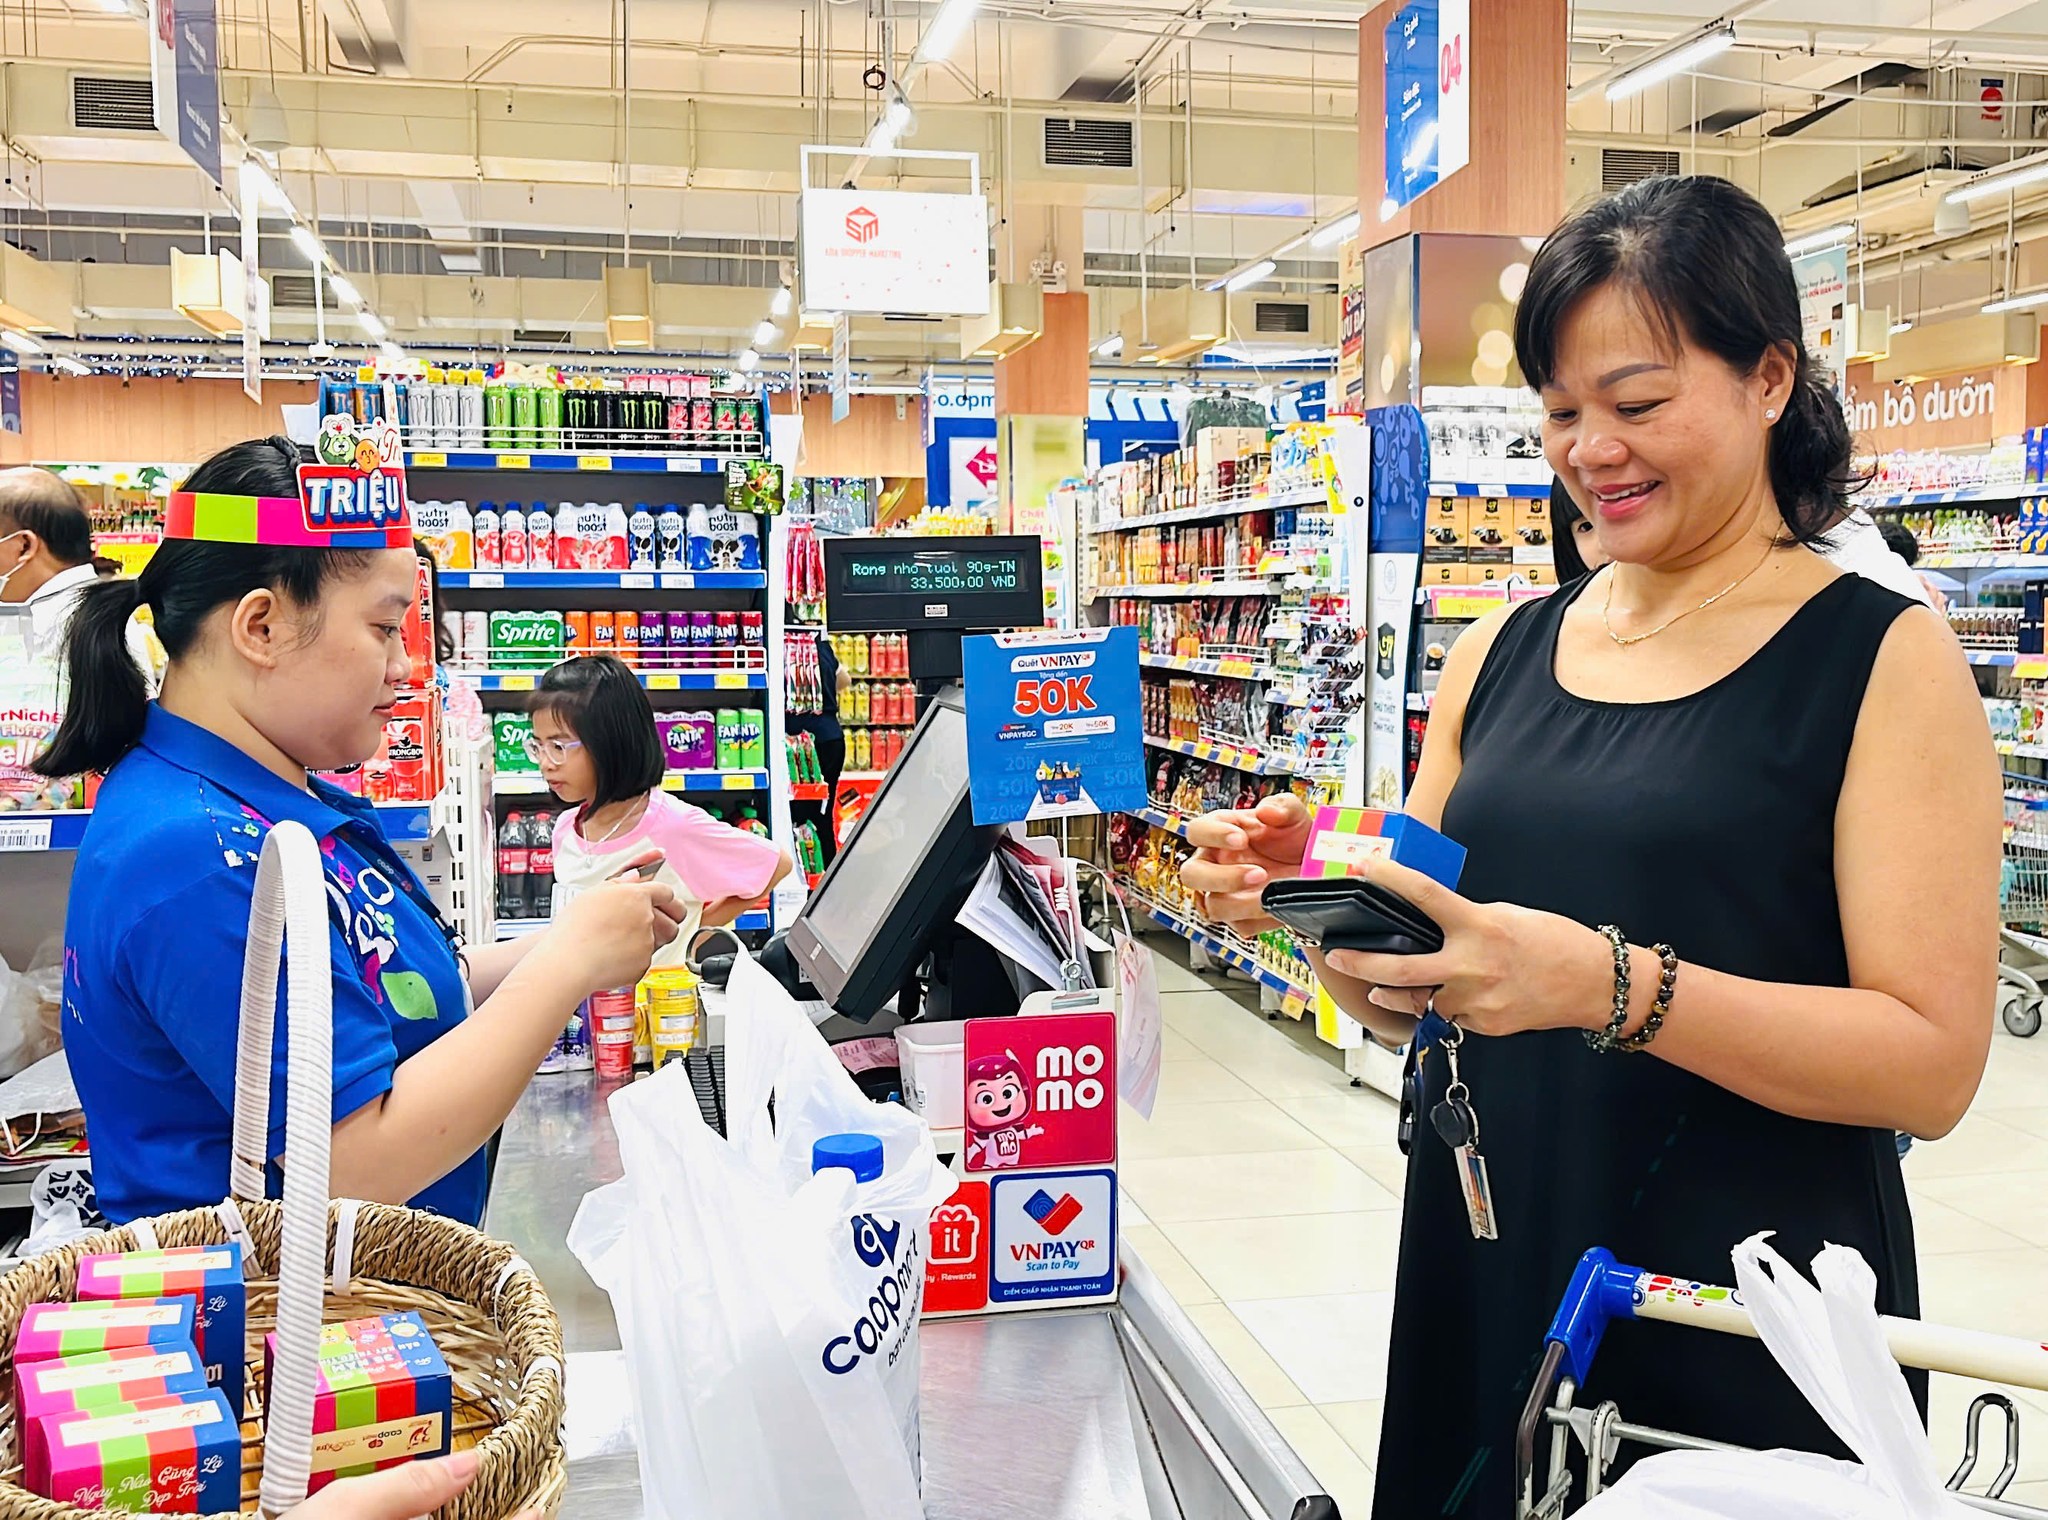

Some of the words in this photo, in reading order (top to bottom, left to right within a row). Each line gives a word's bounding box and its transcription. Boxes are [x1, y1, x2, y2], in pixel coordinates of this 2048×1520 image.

[1440, 34, 1462, 95] 04
[305, 468, 399, 519] TRIỆU
[418, 518, 449, 528] boost
[577, 512, 607, 523] nutri
[709, 512, 737, 523] nutri
[577, 522, 607, 532] boost
[709, 521, 739, 532] boost
[852, 563, 886, 576] Rong
[966, 560, 1016, 574] 90g-TN
[910, 576, 984, 589] 33.500,00
[991, 575, 1016, 588] VND
[497, 621, 556, 645] Sprite
[1013, 675, 1097, 715] 50K
[666, 729, 703, 746] FANTA
[999, 730, 1037, 740] VNPAYSGC
[1026, 1261, 1048, 1271] Scan
[1051, 1261, 1060, 1270] to
[1063, 1258, 1080, 1271] Pay
[941, 1271, 977, 1281] Rewards
